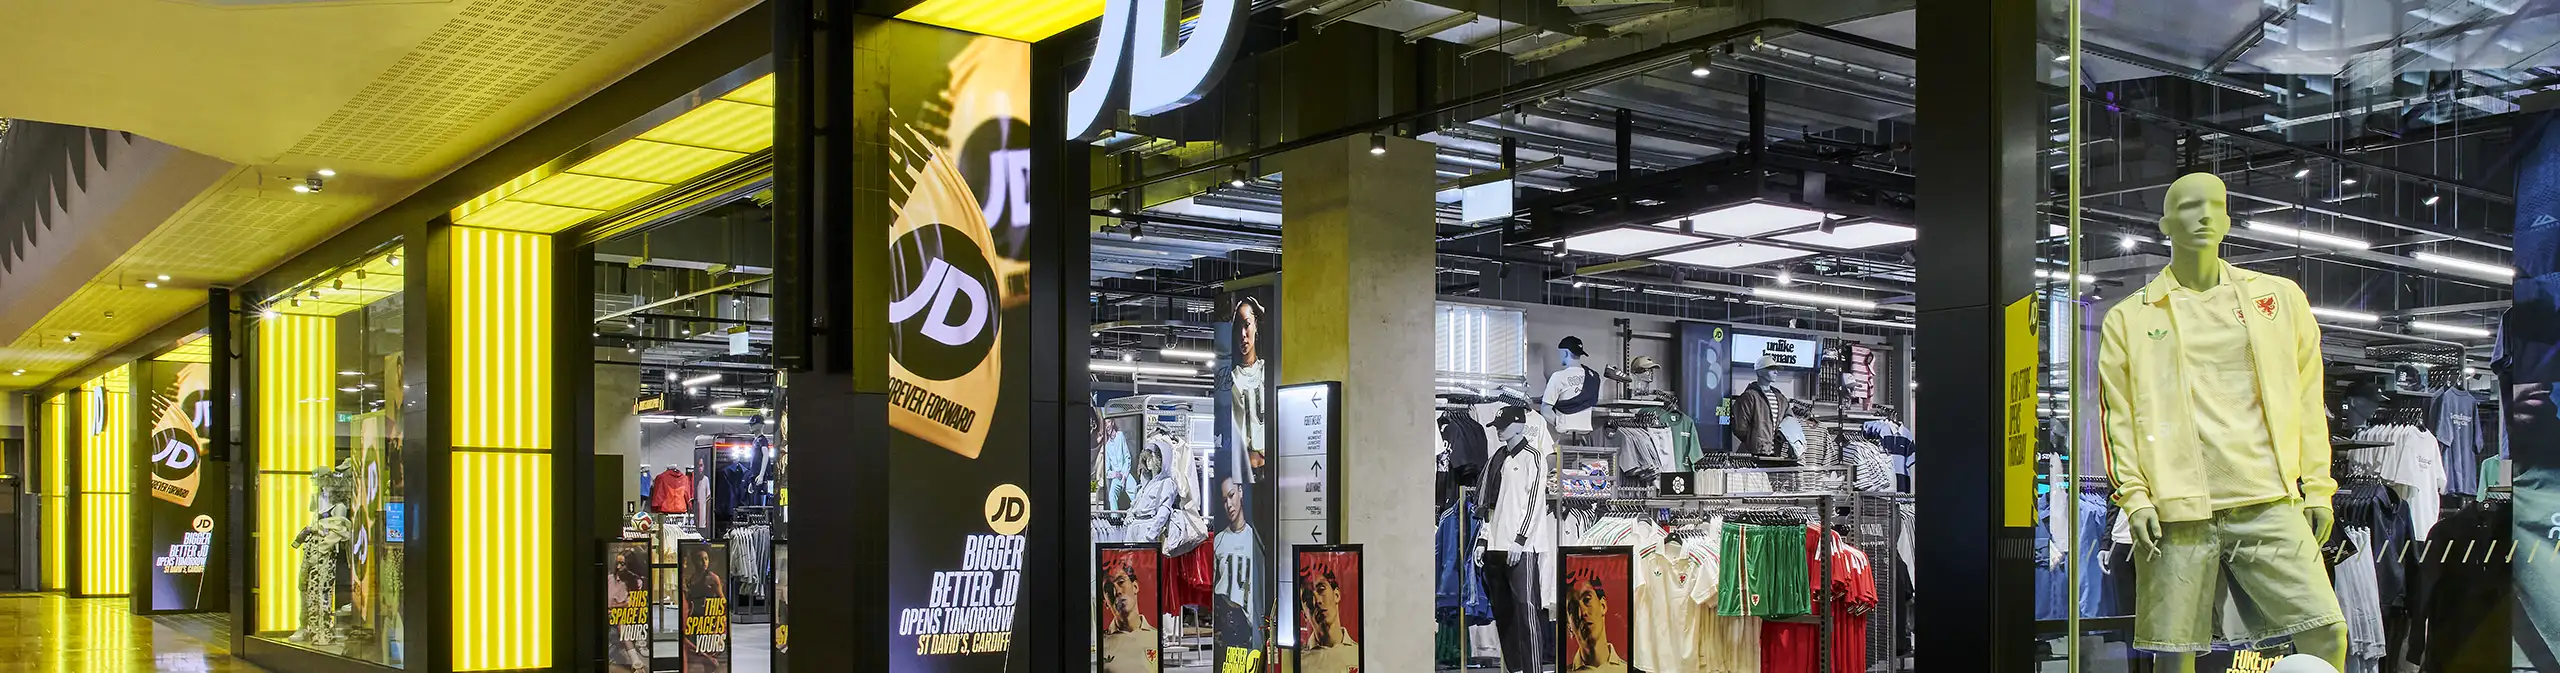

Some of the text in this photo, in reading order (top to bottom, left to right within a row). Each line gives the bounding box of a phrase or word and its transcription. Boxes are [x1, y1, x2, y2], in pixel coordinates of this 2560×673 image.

[1766, 339, 1795, 353] unlike
[888, 375, 976, 434] OREVER FORWARD
[991, 496, 1025, 522] JD
[196, 519, 211, 528] JD
[184, 532, 212, 545] BIGGER
[169, 545, 209, 557] BETTER JD
[962, 535, 1026, 571] BIGGER
[156, 556, 207, 567] OPENS TOMORROW
[628, 590, 649, 607] THIS
[929, 571, 1020, 608] BETTER JD
[704, 597, 727, 616] THIS
[609, 607, 649, 625] SPACE IS
[685, 615, 727, 635] SPACE IS
[899, 605, 1016, 636] OPENS TOMORROW
[620, 624, 649, 641] YOURS
[695, 634, 727, 653] YOURS
[917, 632, 1012, 656] ST DAVID'S, CARDIFF
[1226, 646, 1248, 664] FOREVER
